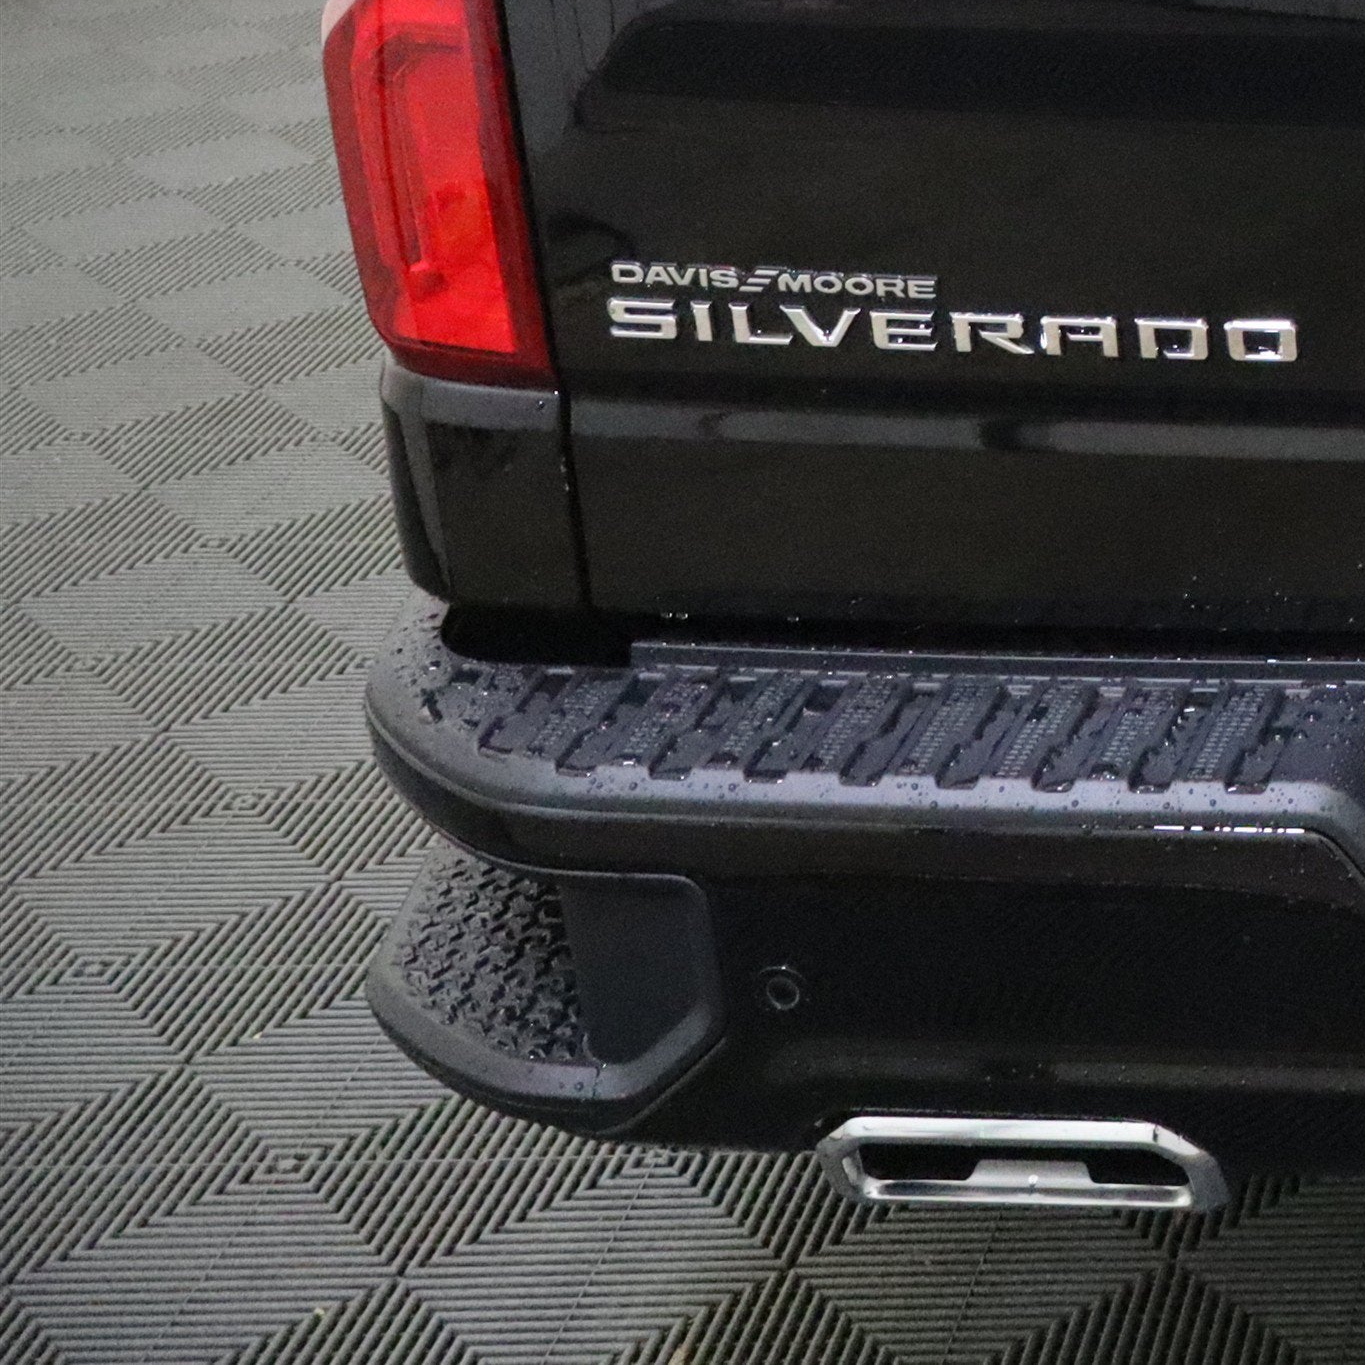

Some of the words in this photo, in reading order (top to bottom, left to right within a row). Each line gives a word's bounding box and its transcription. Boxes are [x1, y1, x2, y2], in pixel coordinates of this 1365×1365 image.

[610, 259, 739, 290] DAVIS
[776, 272, 938, 299] MOORE
[606, 297, 1299, 363] SILVERADO
